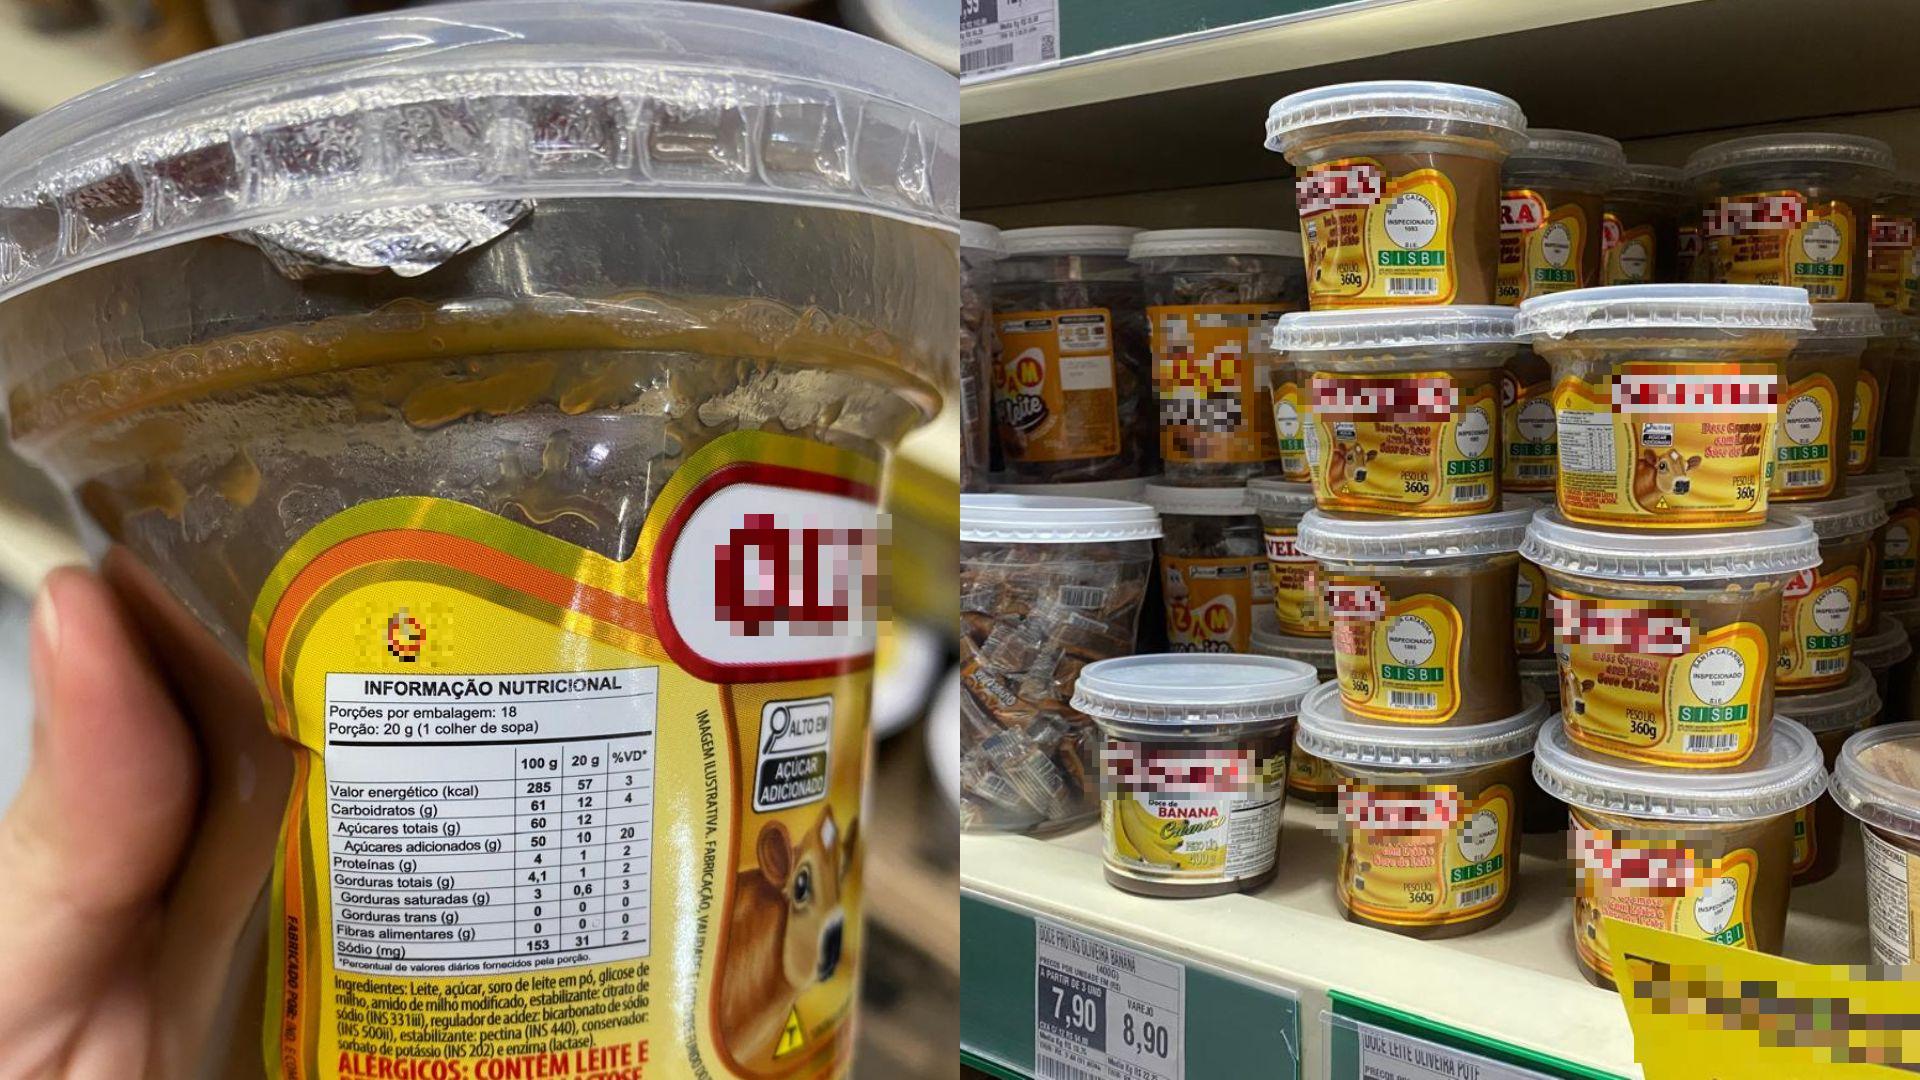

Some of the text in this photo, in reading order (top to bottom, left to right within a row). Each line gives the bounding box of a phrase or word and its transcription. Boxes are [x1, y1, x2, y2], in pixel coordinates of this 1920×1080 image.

[1380, 251, 1441, 265] SISBI
[1340, 272, 1362, 287] 360g
[1779, 446, 1826, 460] SISBI
[1449, 460, 1493, 474] SISBI
[1404, 482, 1429, 496] 360g
[1736, 487, 1755, 502] 360g
[1383, 666, 1439, 681] SISBI
[364, 676, 622, 699] INFORMAÇÃO NUTRICIONAL
[1352, 680, 1369, 696] 360g
[329, 705, 517, 721] Porções por embalagem: 18
[1626, 708, 1644, 720] PESO
[1681, 706, 1744, 721] SISBI
[329, 720, 539, 737] Porção: 20 g (1 colher de sopa)
[788, 716, 828, 737] ALTO EM
[1630, 720, 1657, 739] 360g
[521, 758, 545, 770] 100
[549, 760, 558, 771] g
[571, 755, 588, 767] 20
[591, 757, 600, 767] g
[775, 755, 818, 782] AÇÚCAR
[330, 775, 633, 800] Valor energético (kcal) 285 57 3
[760, 777, 824, 803] ADICIONADO
[331, 792, 633, 818] Carboidratos (g) 61 12 4
[696, 709, 718, 913] IMAGEM ILUSTRATIVA. FABRICAÇÃO,
[1158, 807, 1219, 819] BANANA
[338, 814, 592, 836] Açúcares totais (g) 60 12
[344, 827, 635, 855] Açúcares adicionados (g) 50 10 20
[334, 845, 631, 873] Proteínas (g) 4 1 2
[1453, 856, 1501, 882] SISBI
[334, 862, 631, 890] Gorduras totais (g) 4,1 1 2
[341, 879, 630, 906] Gorduras saturadas (g) 3 0,6 3
[1408, 891, 1434, 905] 360g
[341, 896, 630, 926] Gorduras trans (g) 0 0 0
[336, 913, 630, 942] Fibras alimentares (g) 0 0 0
[337, 930, 629, 959] Sódio (mg) 153 31 2
[335, 962, 650, 998] Ingredientes: Leite, açúcar, soro de leite em pó, glicose de
[335, 980, 649, 1012] milho, amido de milho modificado, estabilizante: citrato de
[1127, 998, 1154, 1018] VAREJO
[336, 1008, 364, 1022] sódio
[366, 1010, 389, 1026] (INS
[431, 1014, 485, 1029] regulador
[487, 1012, 501, 1025] de
[503, 1010, 541, 1025] acidez:
[543, 1003, 606, 1021] bicarbonato
[608, 999, 621, 1012] de
[623, 995, 649, 1010] sódio
[1052, 985, 1097, 1033] 7,90
[337, 1022, 359, 1037] (INS
[400, 1026, 477, 1042] estabilizante:
[480, 1028, 522, 1044] pectina
[525, 1022, 548, 1039] (INS
[551, 1020, 579, 1036] 440),
[582, 1012, 649, 1031] conservador:
[1123, 1013, 1168, 1059] 8,90
[576, 1043, 632, 1074] LEITE
[638, 1039, 649, 1063] E
